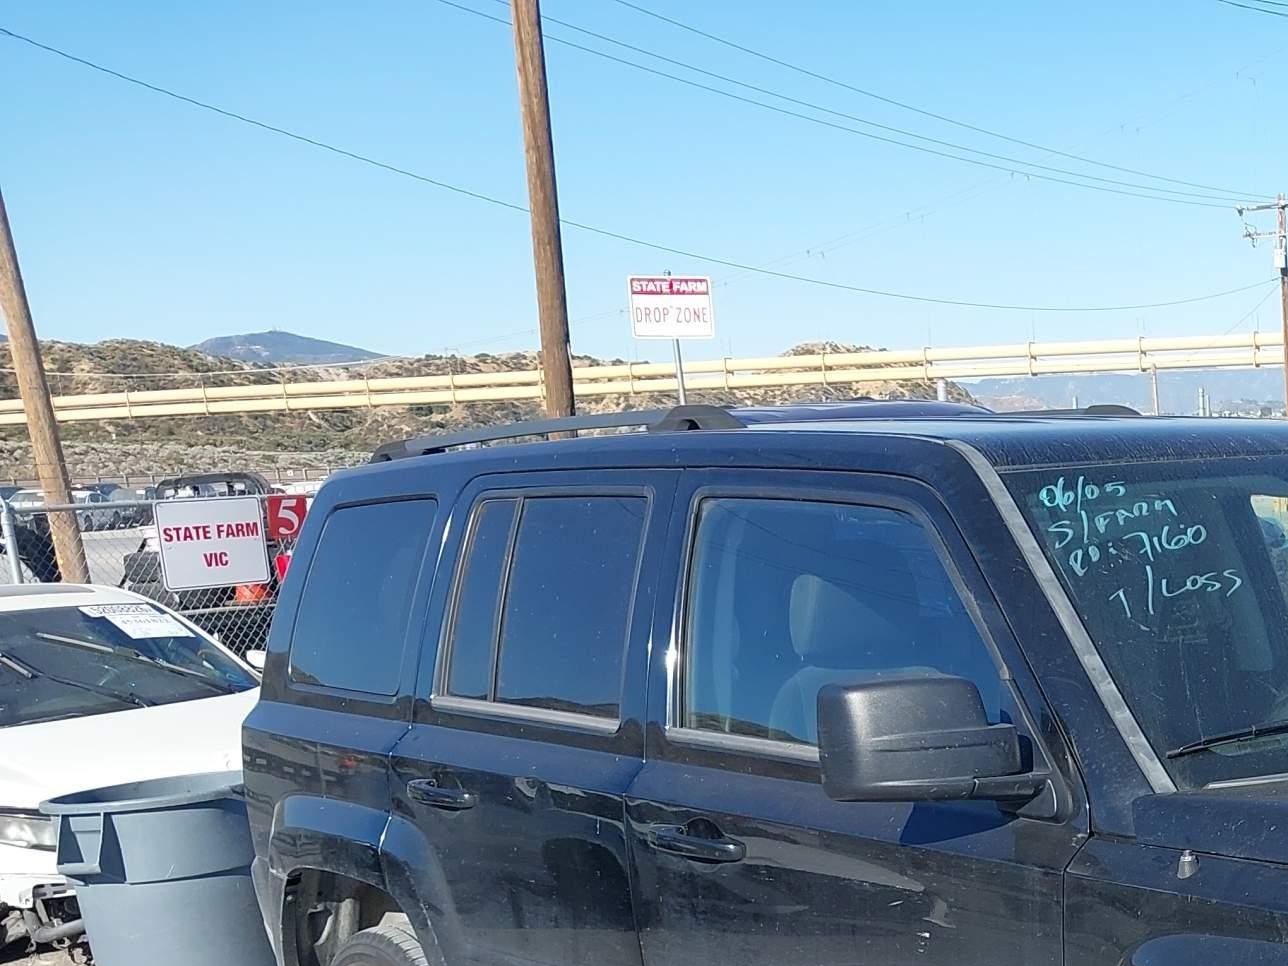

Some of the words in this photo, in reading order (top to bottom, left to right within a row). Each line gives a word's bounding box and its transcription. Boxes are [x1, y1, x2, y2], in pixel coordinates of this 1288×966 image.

[631, 281, 670, 292] STATE
[673, 281, 707, 292] FARM
[636, 306, 670, 323] DROP
[676, 306, 709, 323] ZONE
[1039, 475, 1126, 513] 06/05
[277, 498, 299, 535] 5
[163, 525, 212, 543] STATE
[216, 522, 259, 539] FARM
[203, 551, 229, 567] VIC
